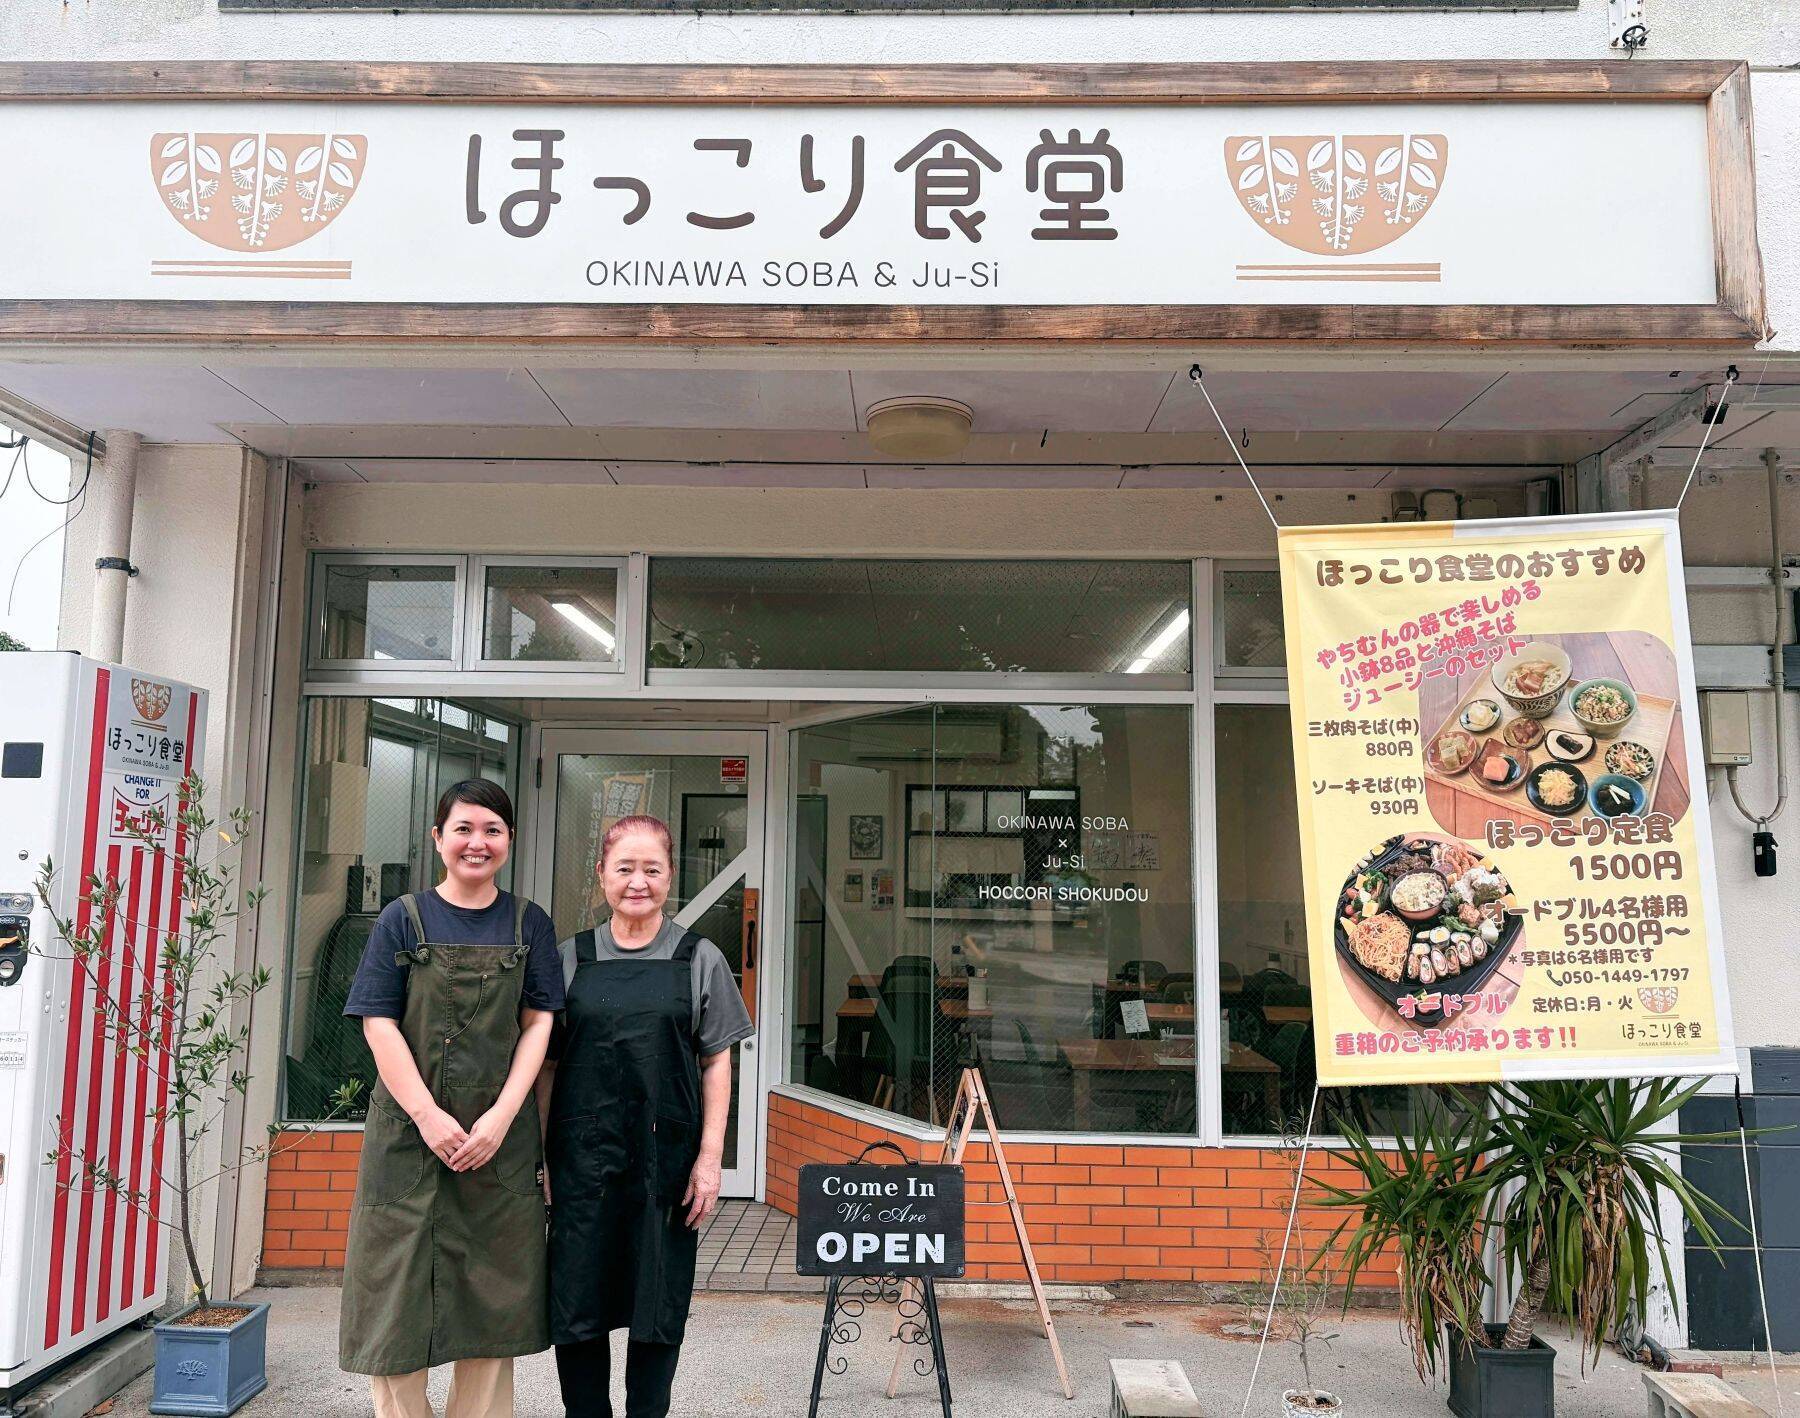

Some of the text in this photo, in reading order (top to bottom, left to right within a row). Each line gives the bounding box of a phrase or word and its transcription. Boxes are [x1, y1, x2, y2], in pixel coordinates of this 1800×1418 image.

[467, 128, 1124, 244] ほっこり食堂
[586, 261, 999, 288] OKINAWA SOBA & Ju-Si
[1316, 545, 1647, 587] ほっこり食堂のおすすめ
[1315, 579, 1542, 670] やちむんの器で楽しめる
[1339, 611, 1518, 688] 小鉢8品と沖縄そば
[1342, 637, 1528, 713] ジューシーのセット
[108, 727, 184, 763] ほっこり食堂
[1365, 740, 1413, 756] 880円
[124, 774, 155, 787] CHANGE
[135, 787, 150, 800] FOR
[1370, 798, 1419, 815] 930円
[997, 815, 1129, 831] OKINAWA SOBA
[1485, 813, 1674, 850] ほっこり定食
[1042, 854, 1085, 869] Ju-Si
[1569, 850, 1683, 880] 1500円
[978, 885, 1150, 902] HOCCORI SHOKUDOU
[1485, 895, 1689, 923] オードブル4名様用
[1562, 968, 1690, 985] 050-1449-1797
[1397, 991, 1509, 1019] オードブル
[1622, 1022, 1702, 1039] ほっこり食堂
[822, 1176, 936, 1197] Come In
[836, 1202, 927, 1223] We Are
[816, 1231, 945, 1264] OPEN
